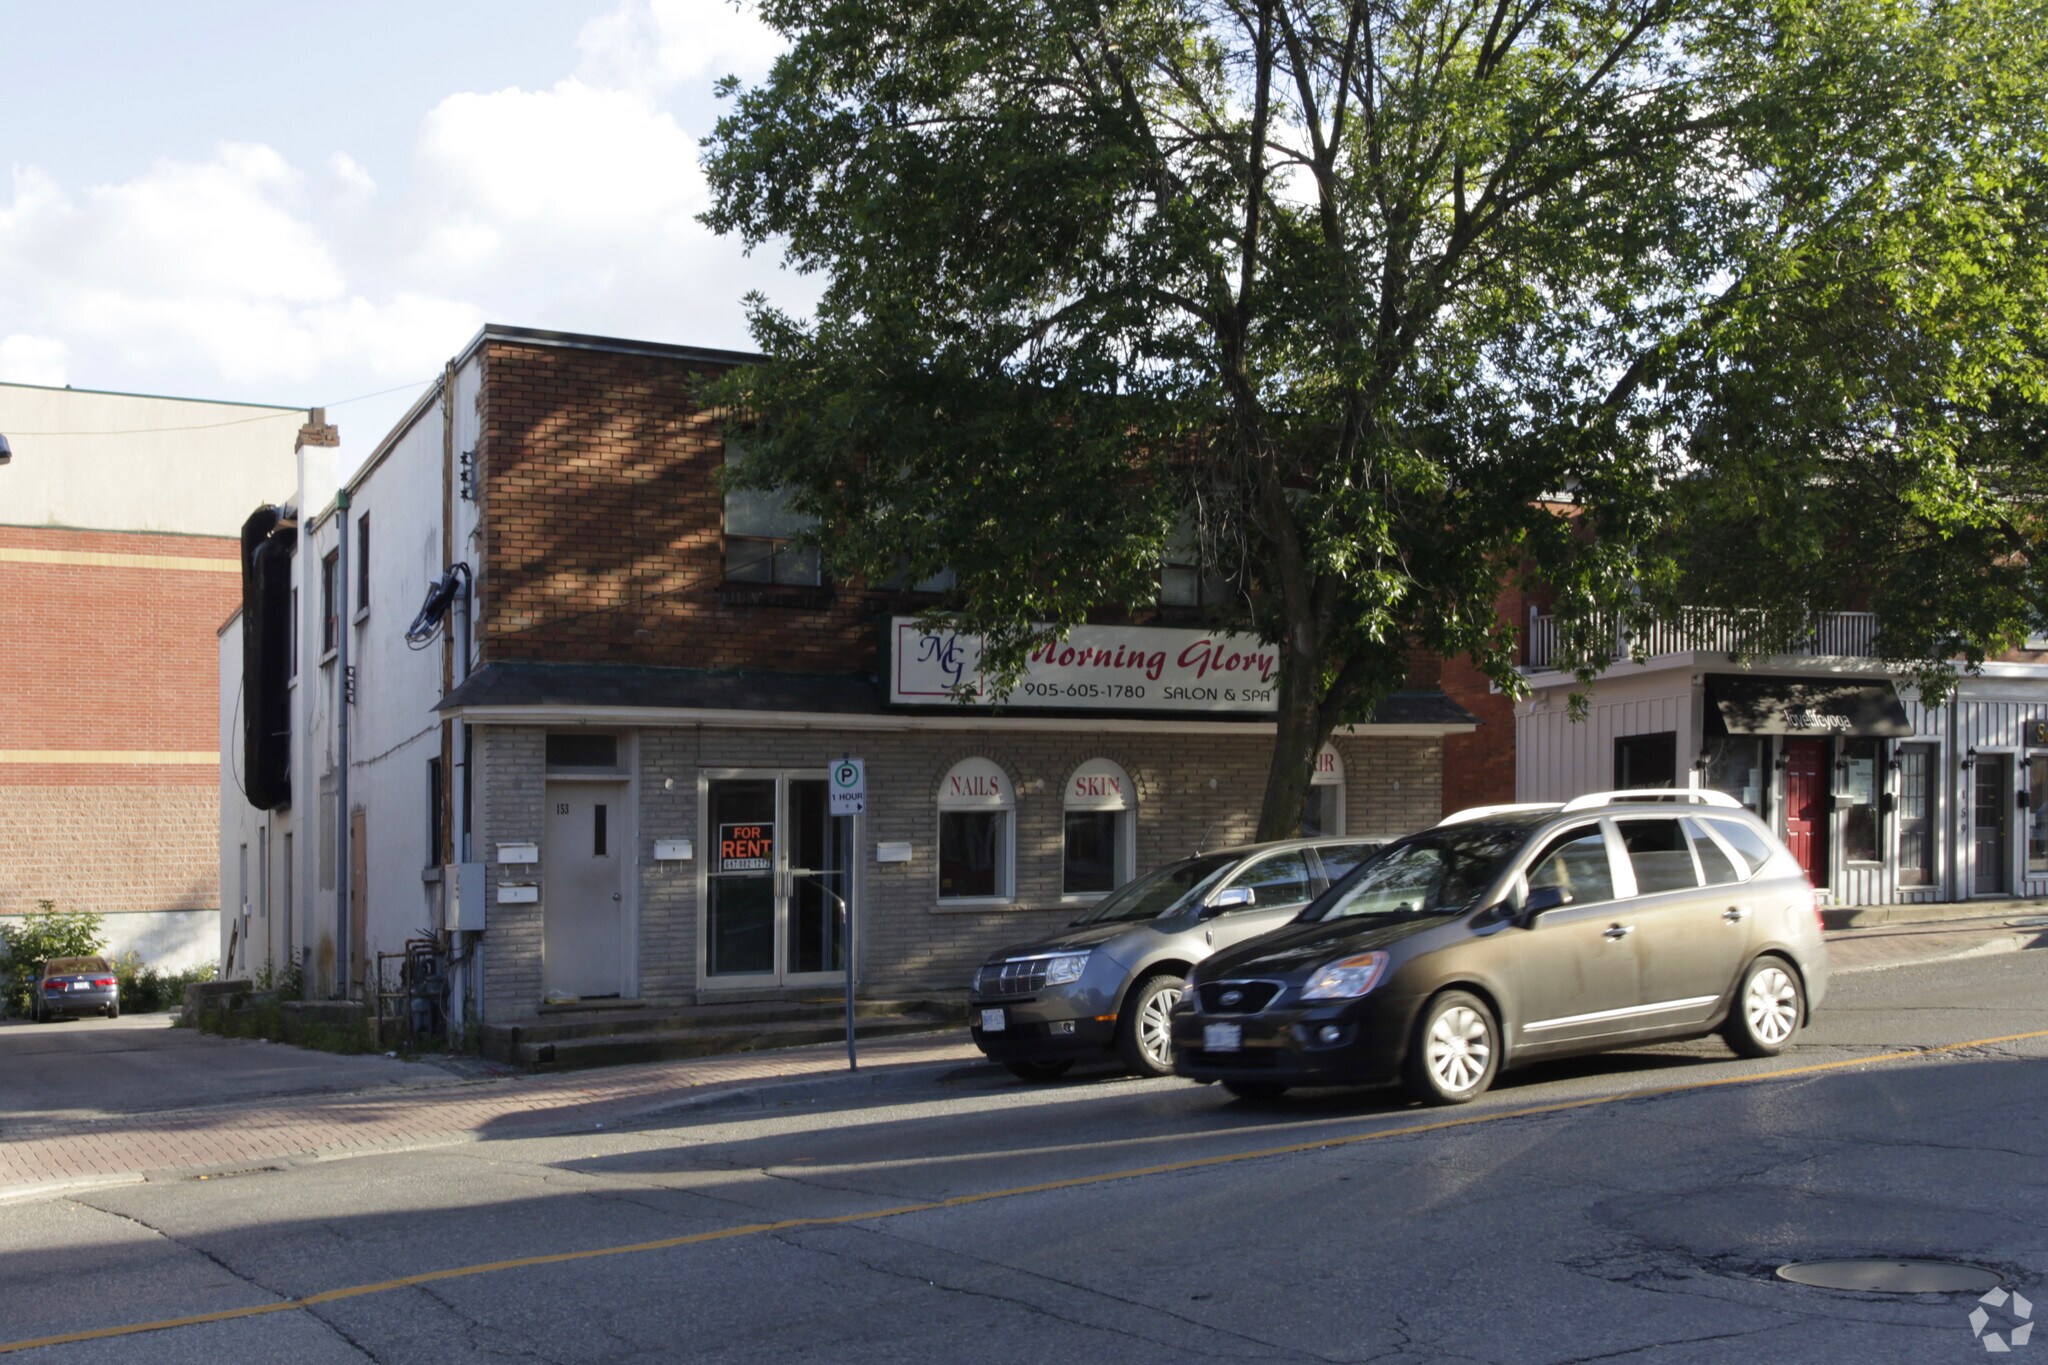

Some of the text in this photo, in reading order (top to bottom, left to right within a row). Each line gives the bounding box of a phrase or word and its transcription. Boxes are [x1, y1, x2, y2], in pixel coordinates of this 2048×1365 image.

[1177, 640, 1274, 683] Glory
[1024, 683, 1270, 702] 905-605-1780 SALON & SPA
[841, 768, 853, 782] P
[950, 775, 998, 796] NAILS
[1075, 776, 1120, 796] SKIN
[839, 793, 863, 801] HOUR
[556, 803, 569, 815] 153
[734, 827, 760, 839] FOR
[722, 840, 771, 858] RENT
